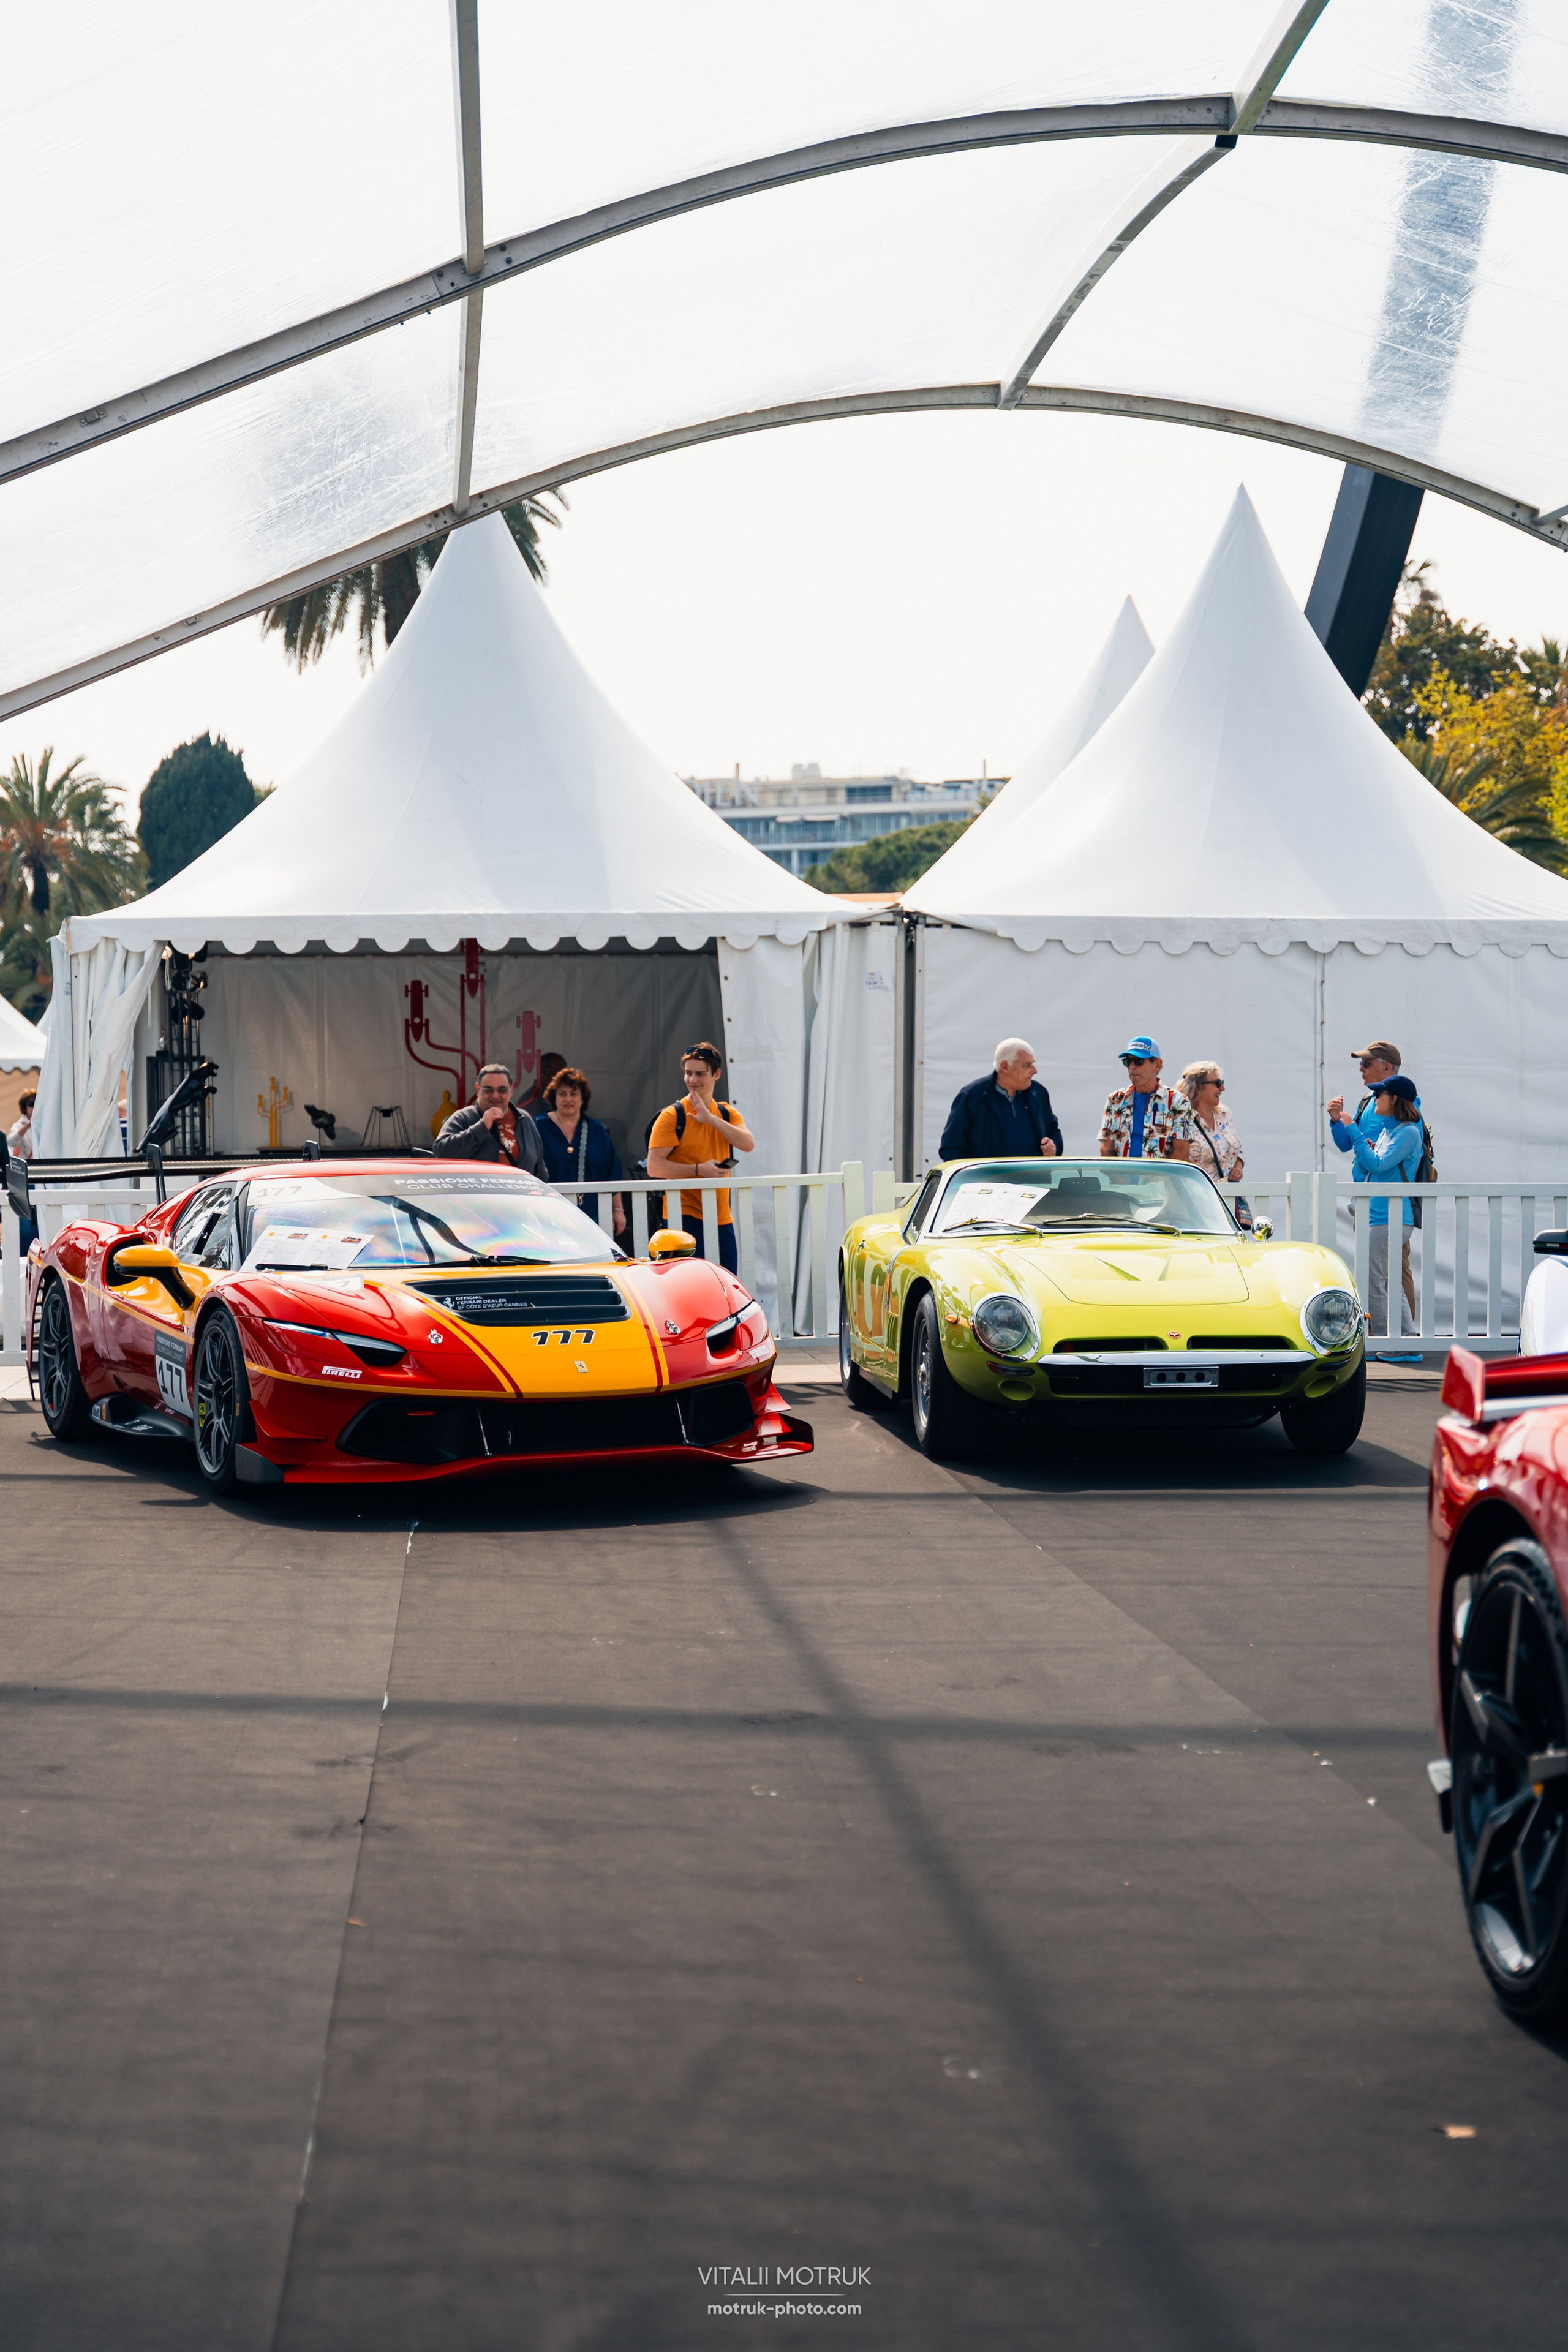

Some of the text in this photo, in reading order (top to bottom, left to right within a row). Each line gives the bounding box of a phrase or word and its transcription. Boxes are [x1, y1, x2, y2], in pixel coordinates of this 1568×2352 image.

[257, 1186, 302, 1197] 177
[456, 1183, 545, 1191] CHALLENGE
[531, 1329, 595, 1346] 177
[171, 1342, 184, 1353] FERRARI
[321, 1365, 363, 1379] PIRELLI
[158, 1360, 184, 1403] 177
